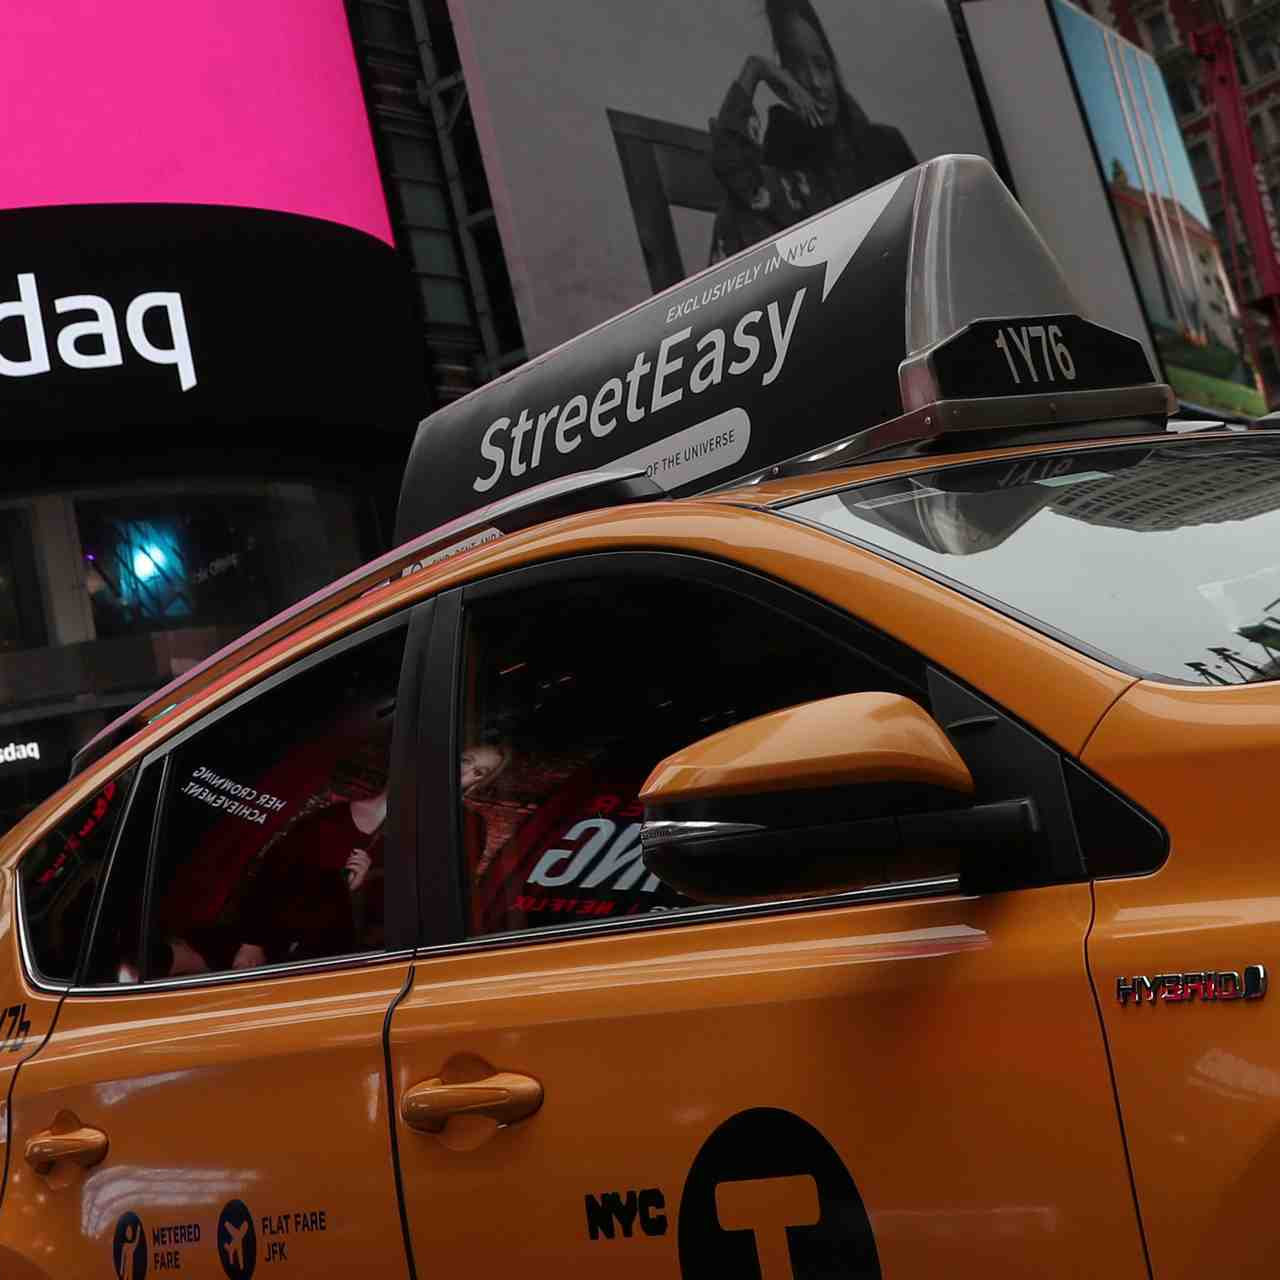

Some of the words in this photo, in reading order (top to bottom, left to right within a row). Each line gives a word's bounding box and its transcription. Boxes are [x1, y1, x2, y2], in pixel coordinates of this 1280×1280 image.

[666, 263, 762, 323] EXCLUSIVELY
[764, 254, 782, 274] IN
[783, 236, 818, 261] NYC
[996, 324, 1074, 383] 1Y76
[473, 287, 808, 493] StreetEasy
[646, 462, 659, 478] OF
[662, 452, 681, 472] THE
[684, 430, 736, 461] UNIVERSE
[1116, 971, 1240, 1006] HYBRID
[152, 1223, 202, 1246] METERED
[261, 1215, 291, 1236] FLAT
[294, 1211, 327, 1232] FARE
[584, 1188, 669, 1241] NYC
[154, 1251, 180, 1271] FARE
[264, 1243, 288, 1263] JFK
